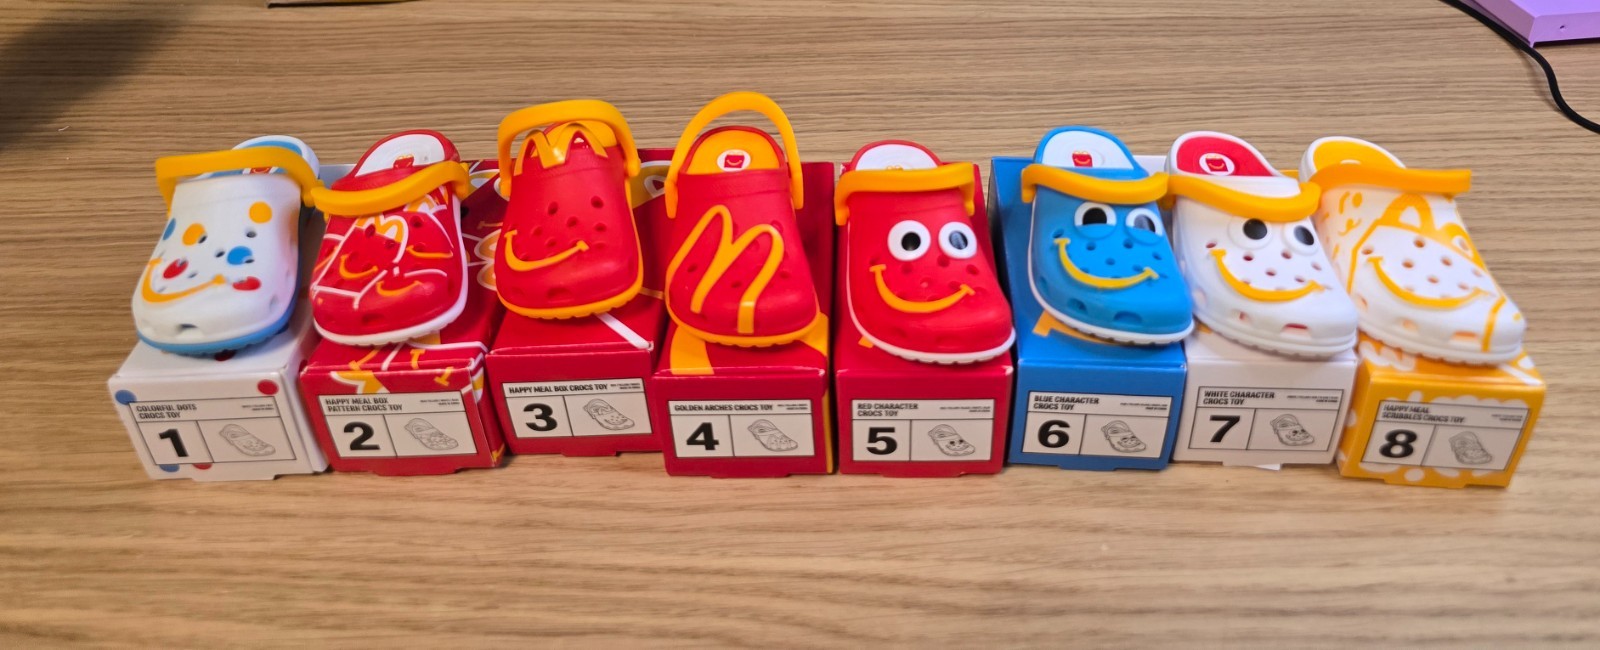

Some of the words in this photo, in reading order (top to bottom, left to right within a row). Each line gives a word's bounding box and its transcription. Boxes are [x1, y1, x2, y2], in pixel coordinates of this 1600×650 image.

[509, 386, 532, 394] HAPPY
[533, 385, 553, 393] MEAL
[569, 384, 594, 392] CROCS
[595, 383, 608, 391] TOY
[1204, 390, 1229, 398] WHITE
[1230, 391, 1275, 399] CHARACTER
[136, 404, 174, 412] COLORFUL
[177, 403, 197, 411] DOTS
[1033, 402, 1059, 410] CROCS
[1060, 403, 1075, 411] TOY
[1034, 395, 1053, 403] BLUE
[1054, 395, 1100, 404] CHARACTER
[1203, 397, 1229, 405] CROCS
[1383, 404, 1409, 413] HAPPY
[1409, 406, 1430, 414] MEAL
[523, 403, 558, 432] 3
[1382, 411, 1423, 421] SCRIBBLES
[1422, 414, 1449, 422] CROCS
[1450, 415, 1465, 423] TOY
[343, 421, 380, 451] 2
[686, 422, 720, 451] 4
[1037, 419, 1071, 448] 6
[1209, 415, 1241, 443] 7
[159, 428, 189, 457] 1
[866, 426, 898, 455] 5
[1379, 429, 1418, 459] 8
